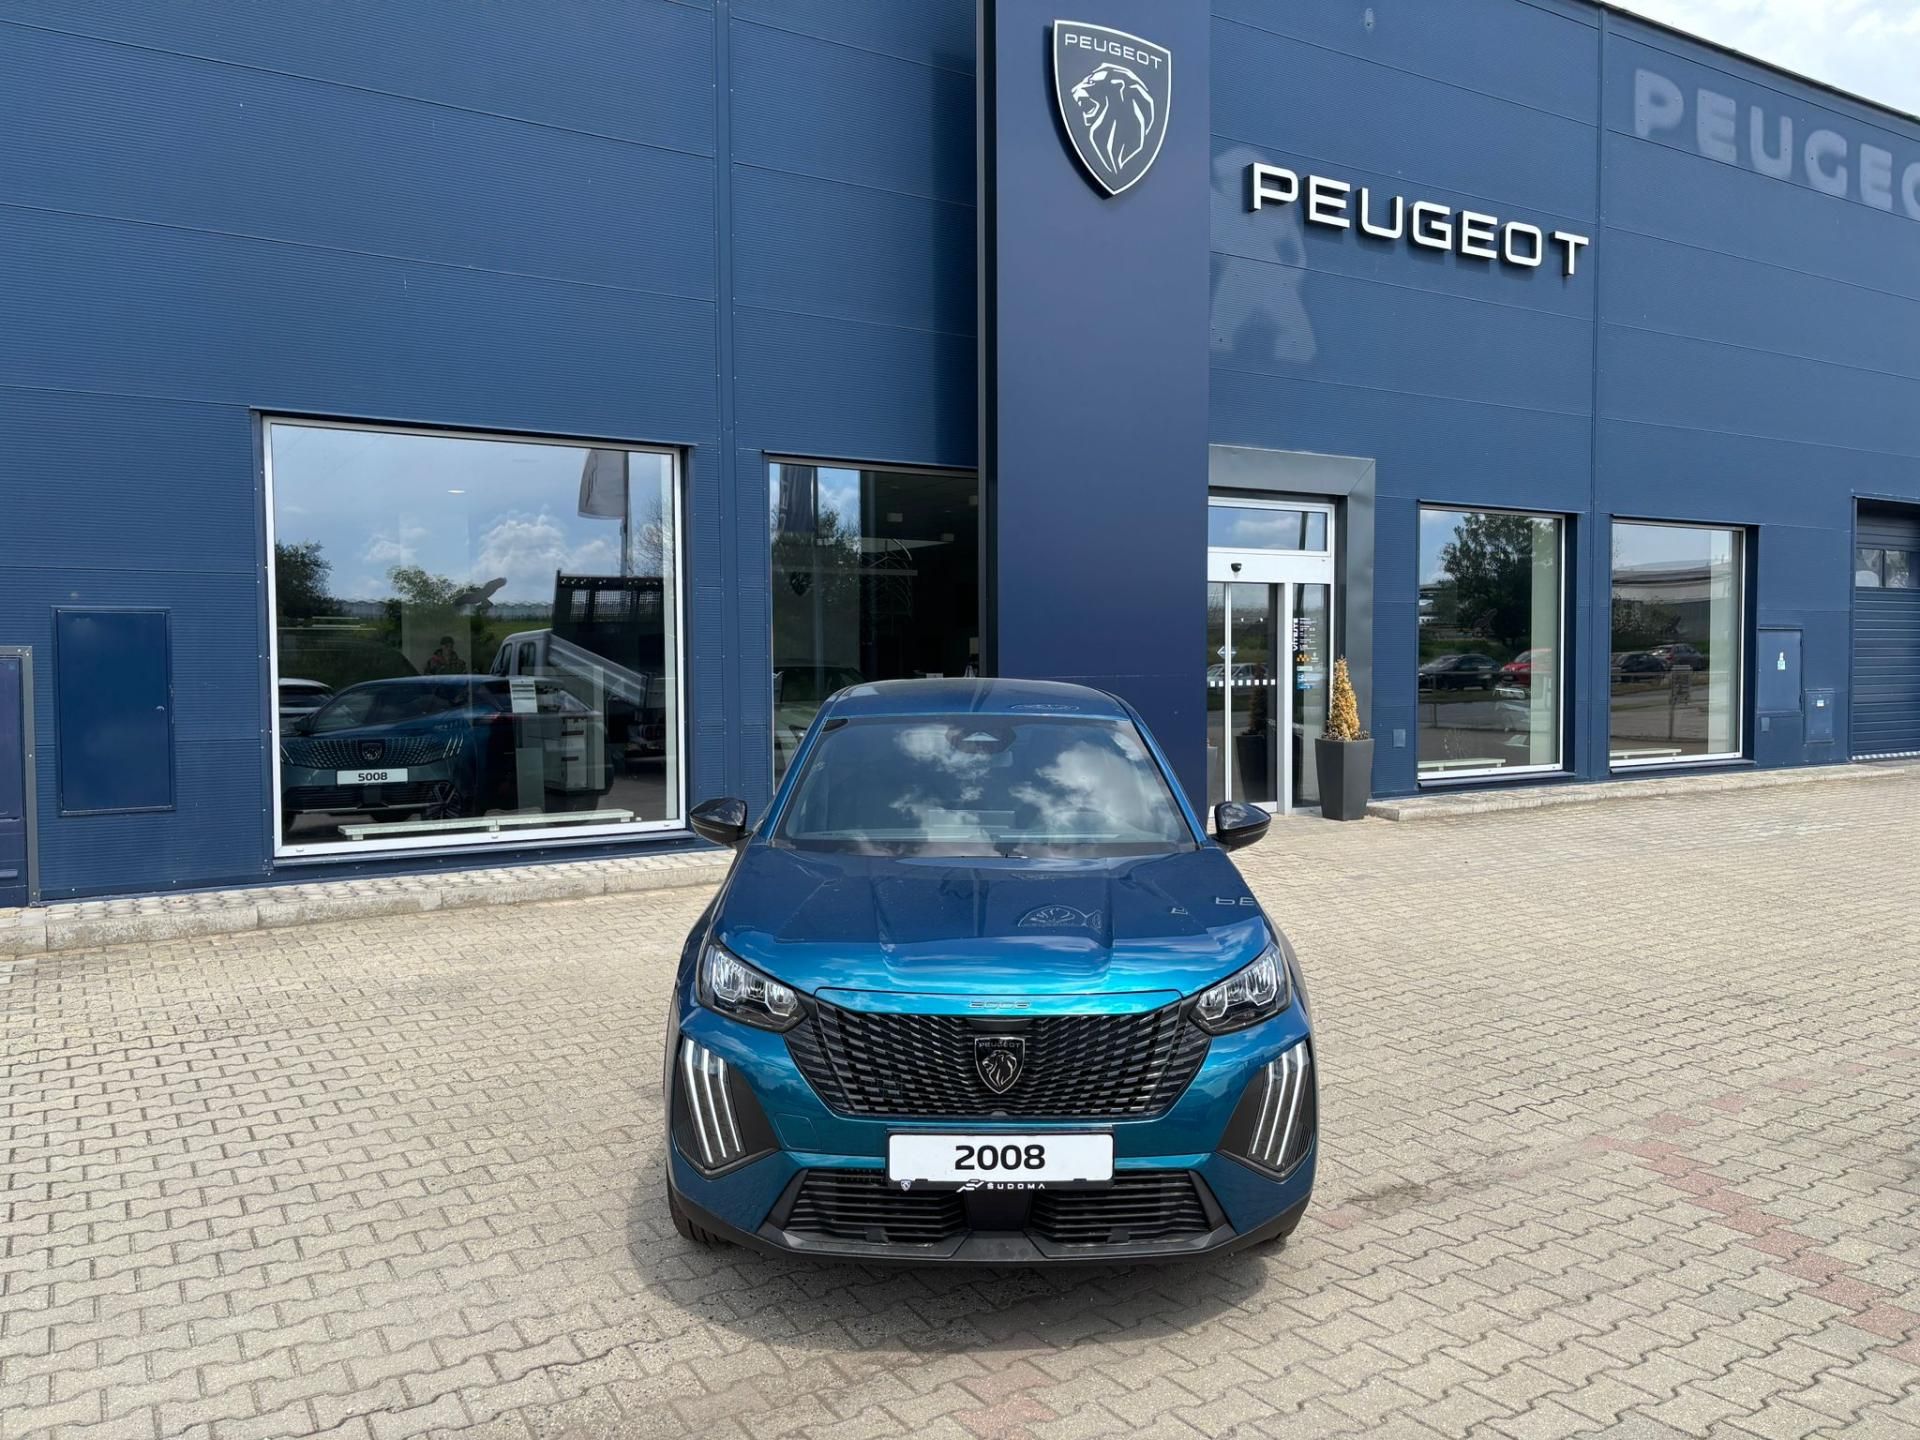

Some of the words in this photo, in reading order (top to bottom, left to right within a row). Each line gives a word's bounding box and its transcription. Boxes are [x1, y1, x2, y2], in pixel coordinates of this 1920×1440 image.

[1064, 33, 1163, 69] PEUGEOT
[1250, 161, 1590, 277] PEUGEOT
[358, 772, 388, 781] 5008
[954, 1144, 1046, 1171] 2008
